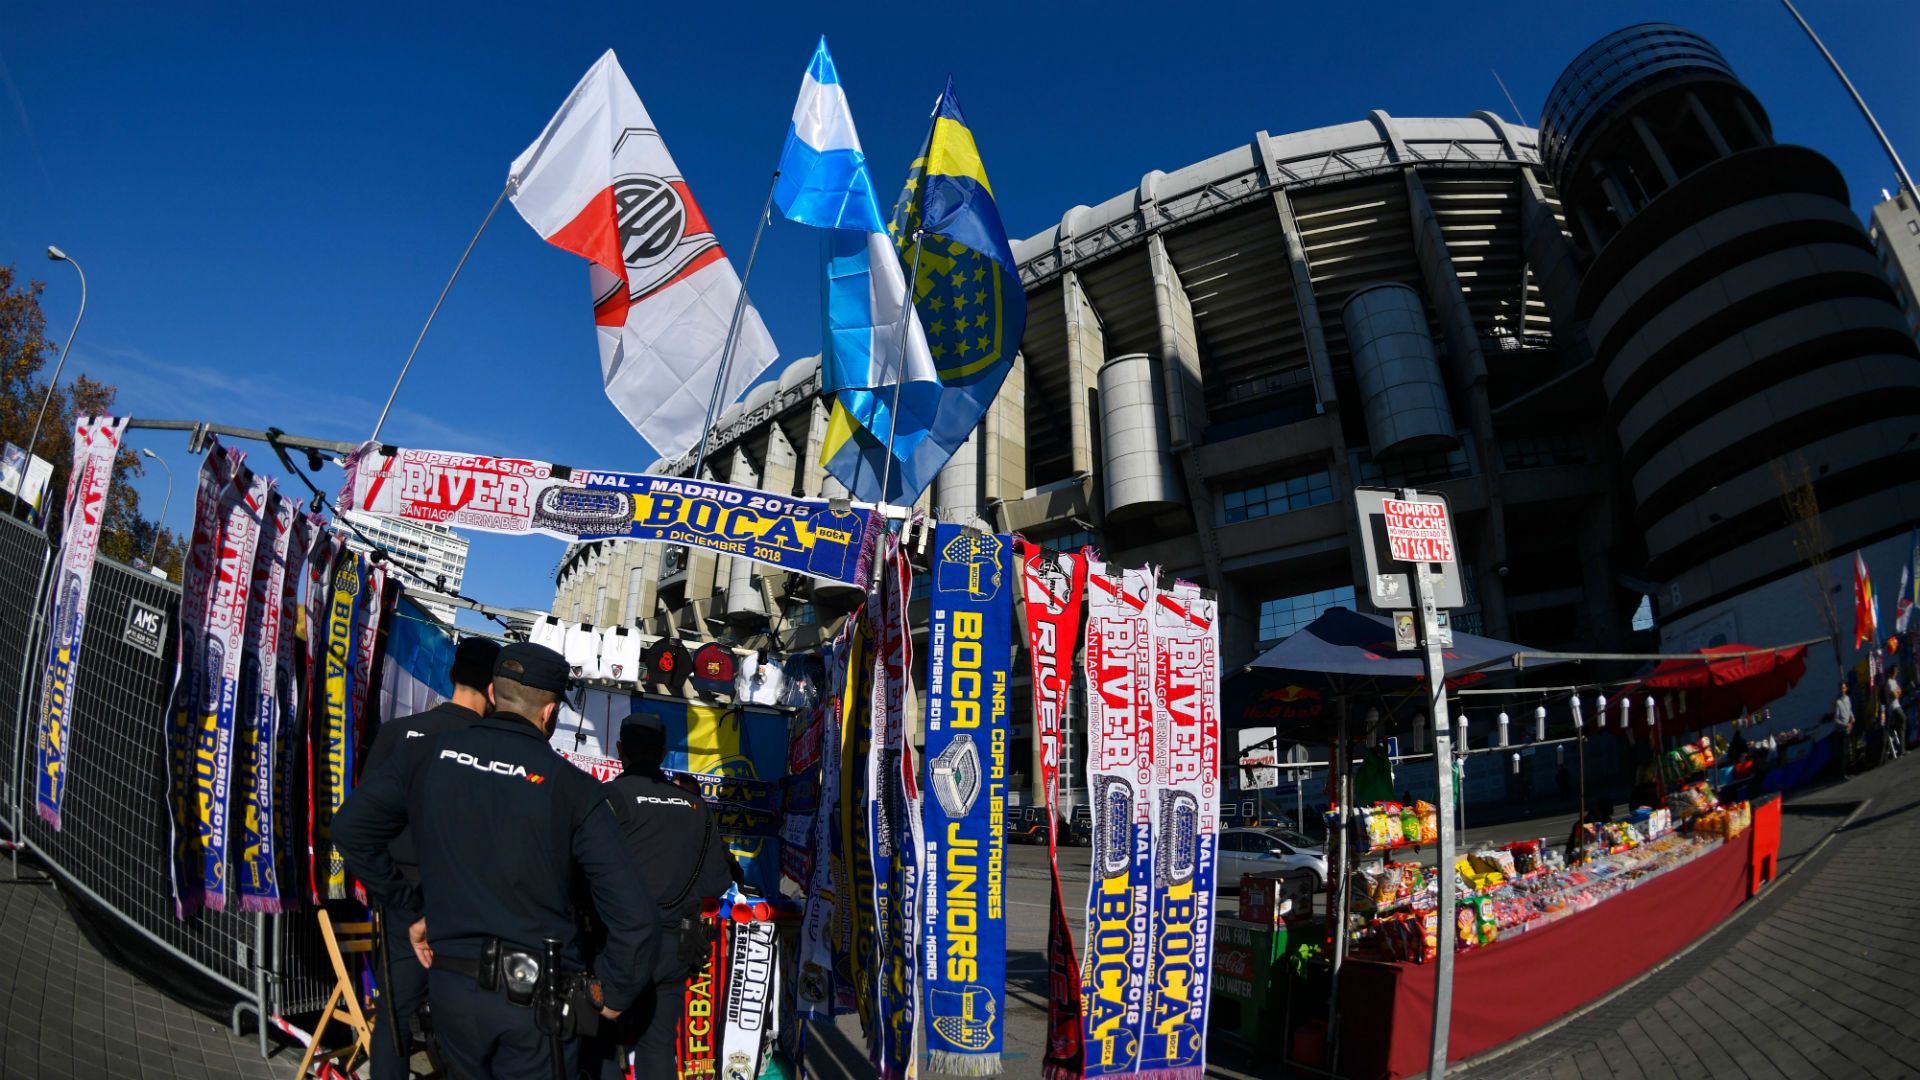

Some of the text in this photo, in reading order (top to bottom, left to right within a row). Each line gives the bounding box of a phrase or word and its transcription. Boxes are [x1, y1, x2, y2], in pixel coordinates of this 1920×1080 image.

[402, 450, 551, 480] SUPERCLÁSICO
[569, 471, 630, 488] FINAL
[650, 480, 743, 504] MADRID
[400, 503, 528, 531] SANTIAGO BERNABÉU
[401, 462, 805, 553] RIVER BOCA
[819, 528, 846, 541] BOCA
[1387, 515, 1446, 529] TU COCHE
[1388, 502, 1440, 516] COMPRO
[209, 507, 252, 631] RIVER
[670, 531, 746, 554] DICIEMBRE
[753, 546, 782, 562] 2018
[1392, 537, 1452, 560] 617 161 475
[134, 608, 160, 634] AMS
[327, 600, 350, 679] BOCA
[932, 623, 946, 695] DICIEMBRE
[950, 610, 983, 730] BOCA
[1088, 617, 1101, 690] SANTIAGO
[1156, 636, 1167, 708] SANTIAGO
[930, 697, 942, 731] 2018
[1037, 619, 1058, 769] RIVER
[1101, 617, 1137, 771] RIVER
[1136, 617, 1150, 785] SUPERCLÁSICO
[1168, 637, 1202, 785] RIVER
[1202, 636, 1214, 799] SUPERCLÁSICO
[215, 728, 229, 798] MADRID
[260, 741, 269, 807] MADRID
[440, 749, 527, 777] POLICIA
[213, 801, 224, 847] 2018
[637, 796, 691, 806] POLICIA
[988, 670, 1006, 920] FINAL COPA LIBERTADORES
[261, 811, 270, 854] 2018
[1134, 803, 1149, 866] FINAL
[1198, 814, 1214, 874] FINAL
[878, 882, 888, 890] 9
[902, 865, 915, 959] MADRID
[946, 821, 978, 983] JUNIORS
[735, 937, 748, 965] REAL
[1132, 885, 1148, 968] MADRID
[1195, 891, 1209, 968] MADRID
[926, 935, 938, 981] MADRID
[1089, 886, 1134, 1040] BOCA
[1152, 893, 1197, 1035] BOCA
[1227, 977, 1252, 998] WATER
[728, 968, 745, 1024] MADRID!
[1127, 974, 1143, 1025] 2018
[1190, 972, 1204, 1021] 2018
[1103, 1038, 1111, 1062] BOCA
[1168, 1034, 1177, 1056] BOCA
